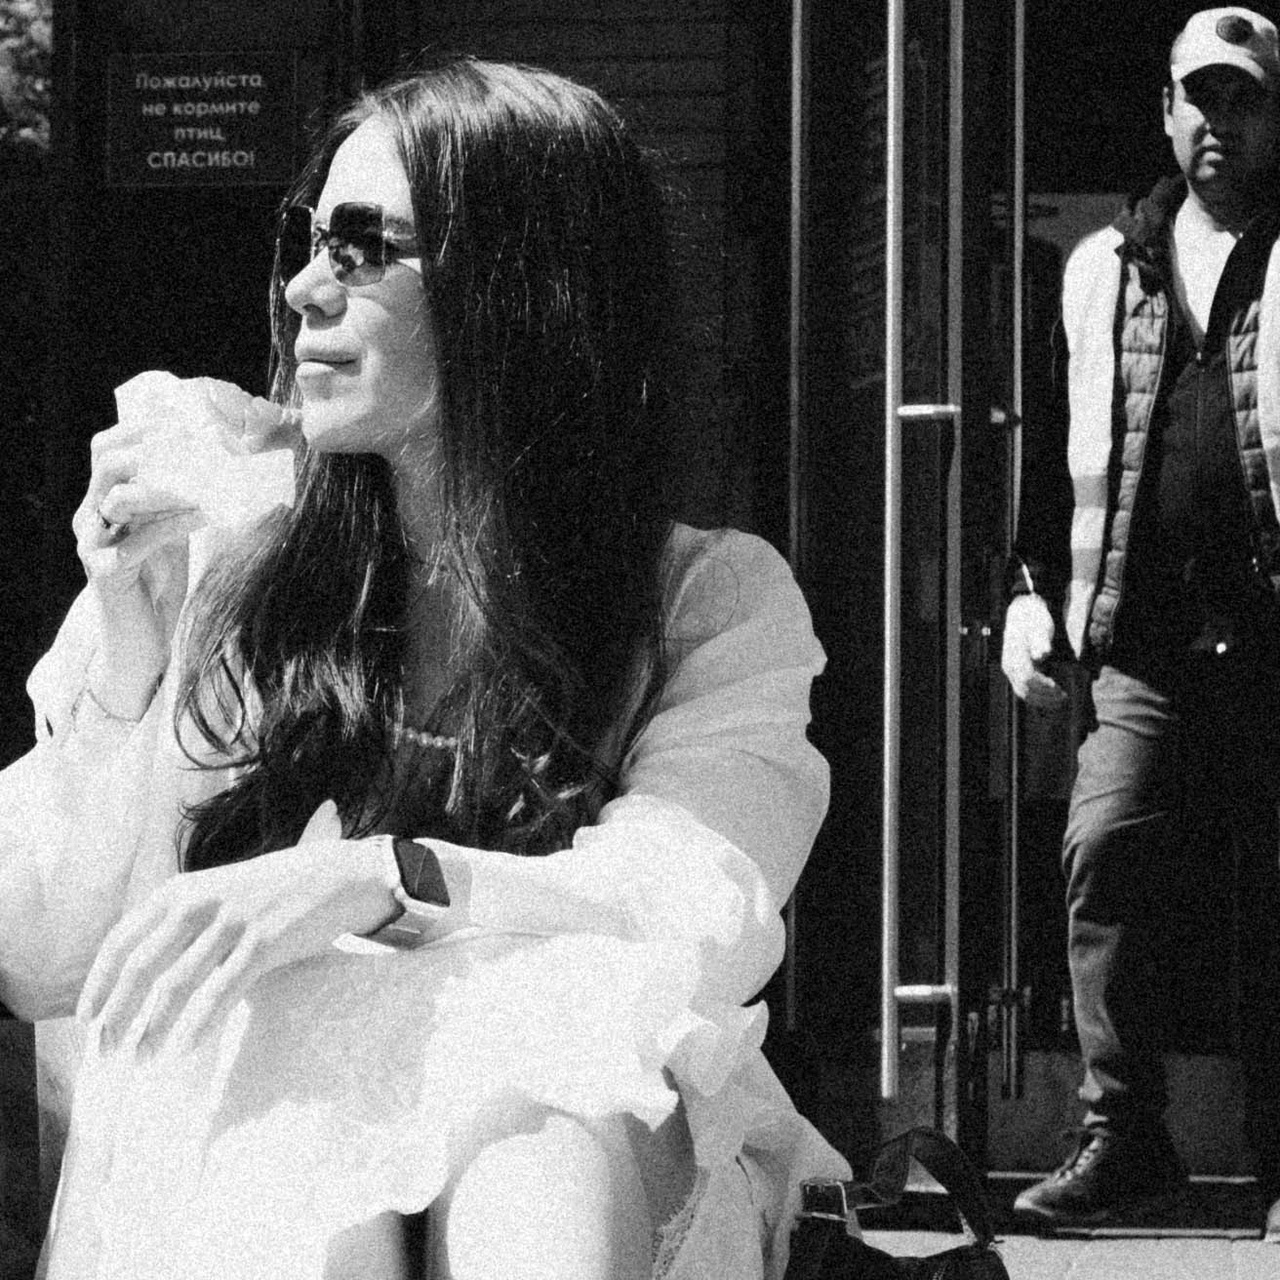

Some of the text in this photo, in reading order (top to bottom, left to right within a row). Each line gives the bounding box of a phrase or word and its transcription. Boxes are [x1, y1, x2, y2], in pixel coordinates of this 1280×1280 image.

[135, 71, 263, 91] Пожалуйста
[142, 100, 261, 118] не кормите
[173, 126, 226, 142] птиц
[147, 150, 255, 169] СПАСИБО!
